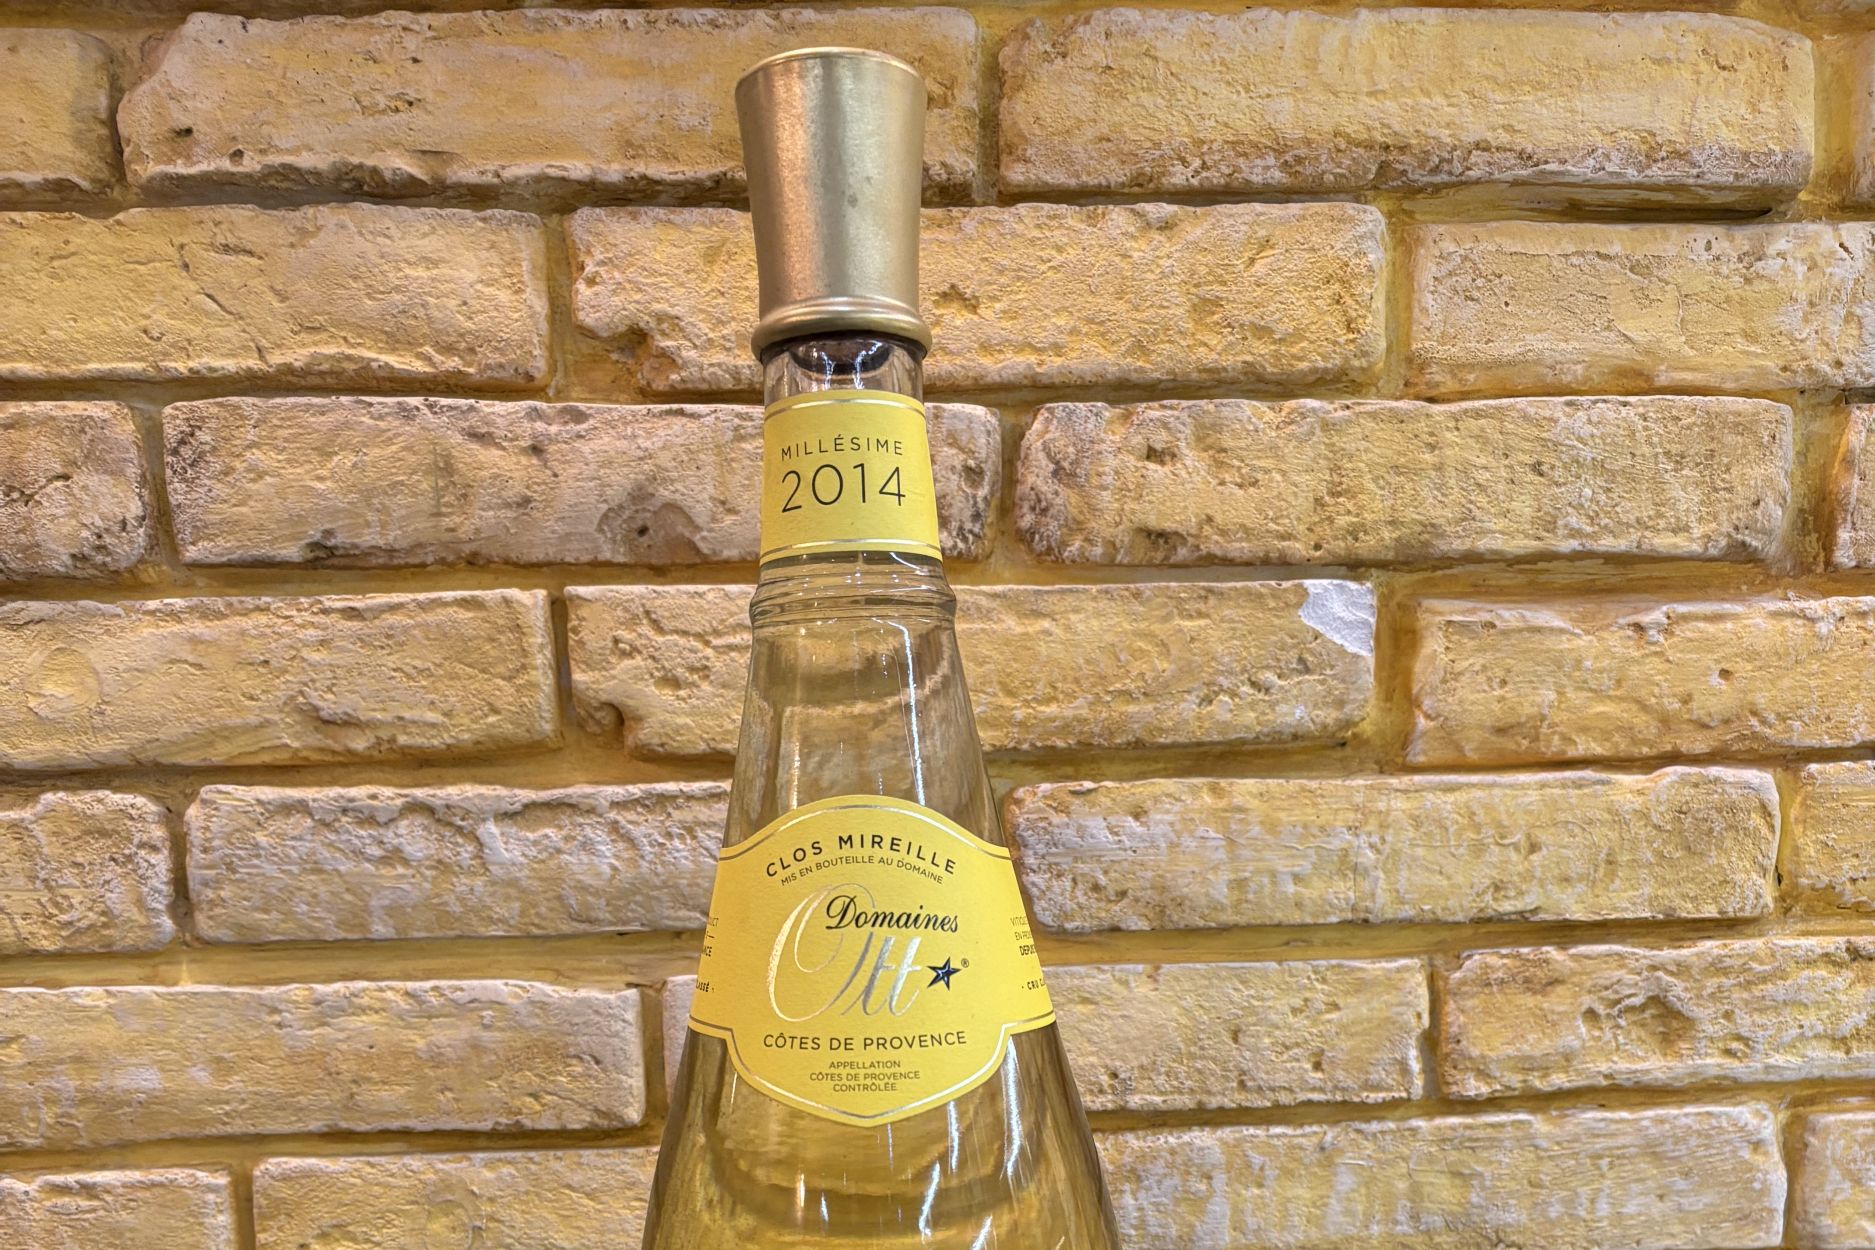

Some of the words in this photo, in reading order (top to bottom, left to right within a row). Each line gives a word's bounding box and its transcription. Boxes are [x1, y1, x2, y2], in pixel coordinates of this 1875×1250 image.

[781, 434, 903, 461] MILLÉSIME
[781, 463, 906, 513] 2014
[766, 841, 823, 877] CLOS
[838, 834, 956, 875] MIREILLE
[781, 873, 797, 886] MIS
[800, 866, 813, 877] EN
[816, 856, 874, 870] BOUTEILLE
[879, 857, 893, 866] AU
[897, 860, 943, 884] DOMAINE
[825, 895, 958, 933] Domaines
[768, 883, 922, 1021] Ott
[763, 1033, 821, 1050] CÔTES
[829, 1037, 855, 1051] DE
[864, 1031, 967, 1050] PROVENCE
[810, 1072, 843, 1082] CÔTES
[846, 1073, 860, 1082] DE
[864, 1071, 920, 1081] PROVENCE
[829, 1060, 901, 1070] APPELLATION
[833, 1082, 897, 1093] CONTRÔLÉE
